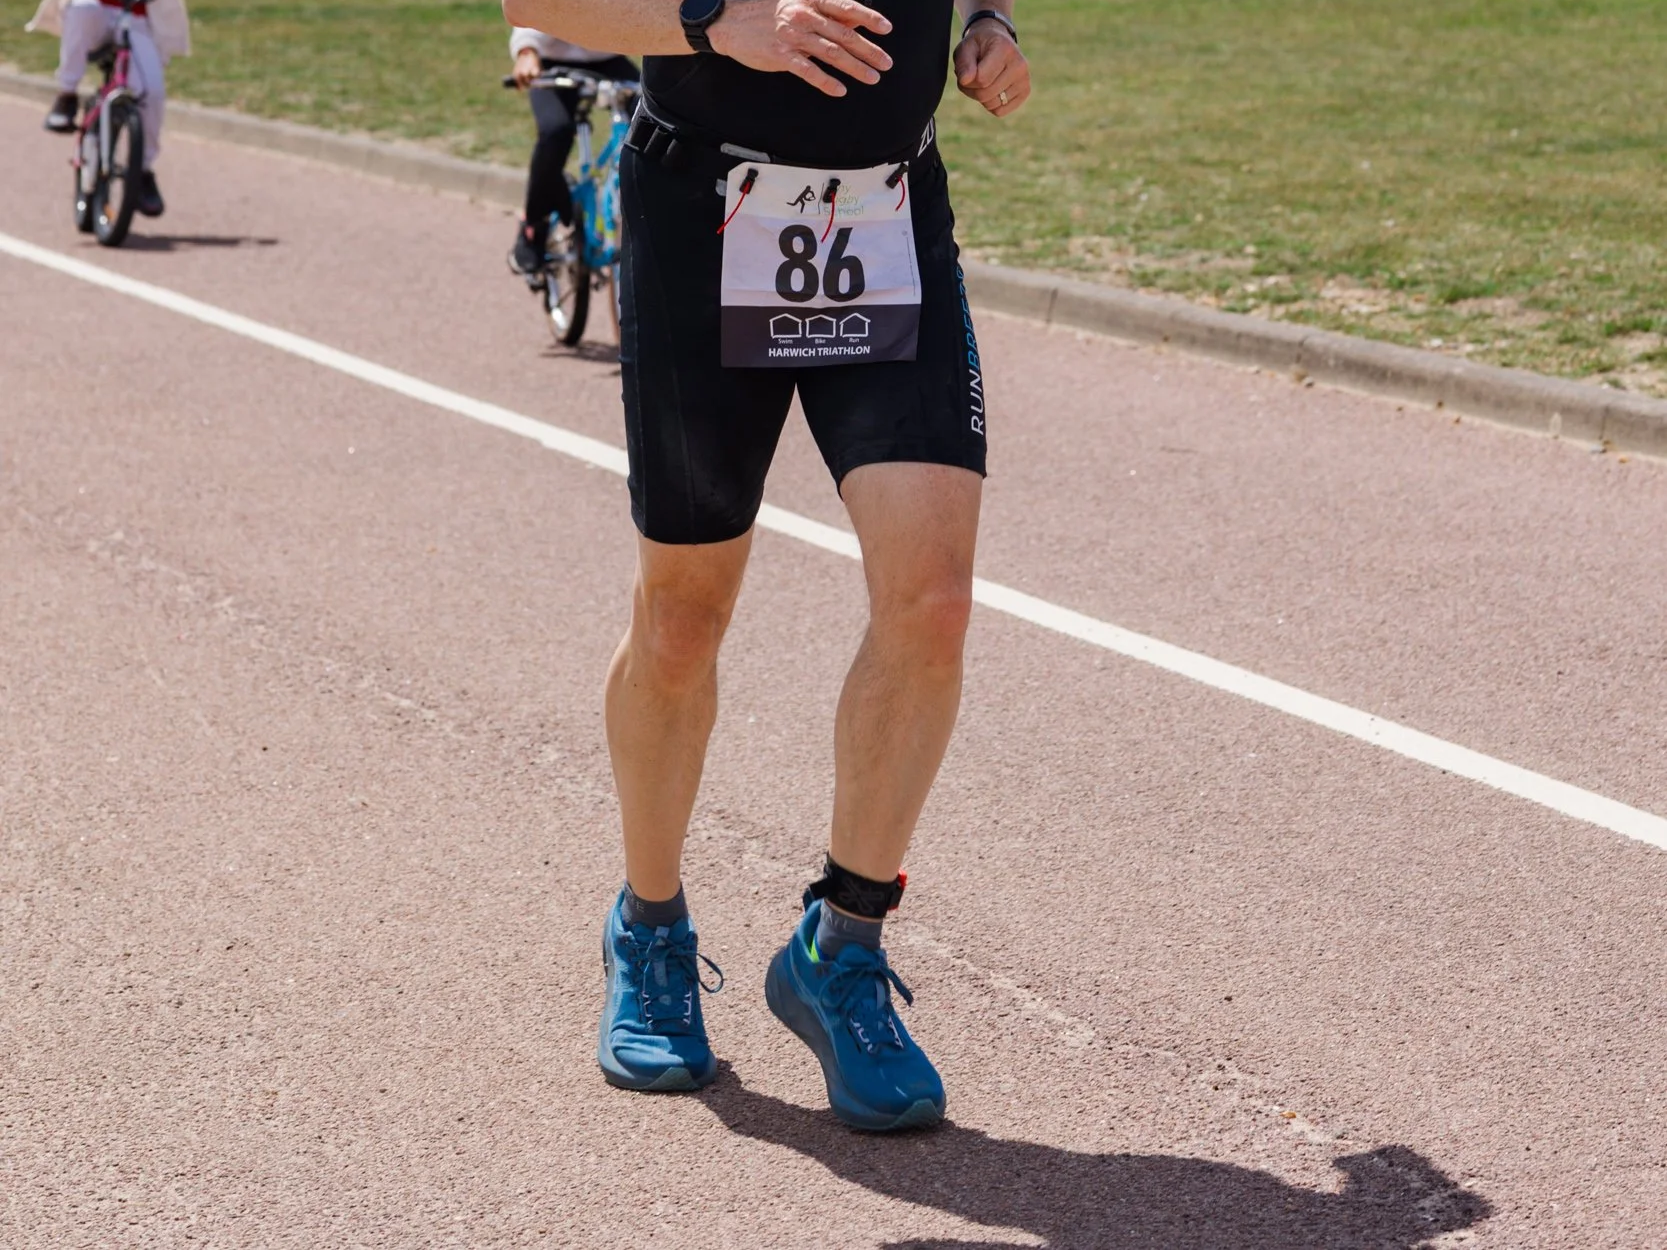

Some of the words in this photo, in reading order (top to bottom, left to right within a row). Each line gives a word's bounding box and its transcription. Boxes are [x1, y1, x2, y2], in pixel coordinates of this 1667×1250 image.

[775, 224, 866, 303] 86
[768, 347, 816, 357] HARWICH
[817, 345, 871, 356] TRIATHLON
